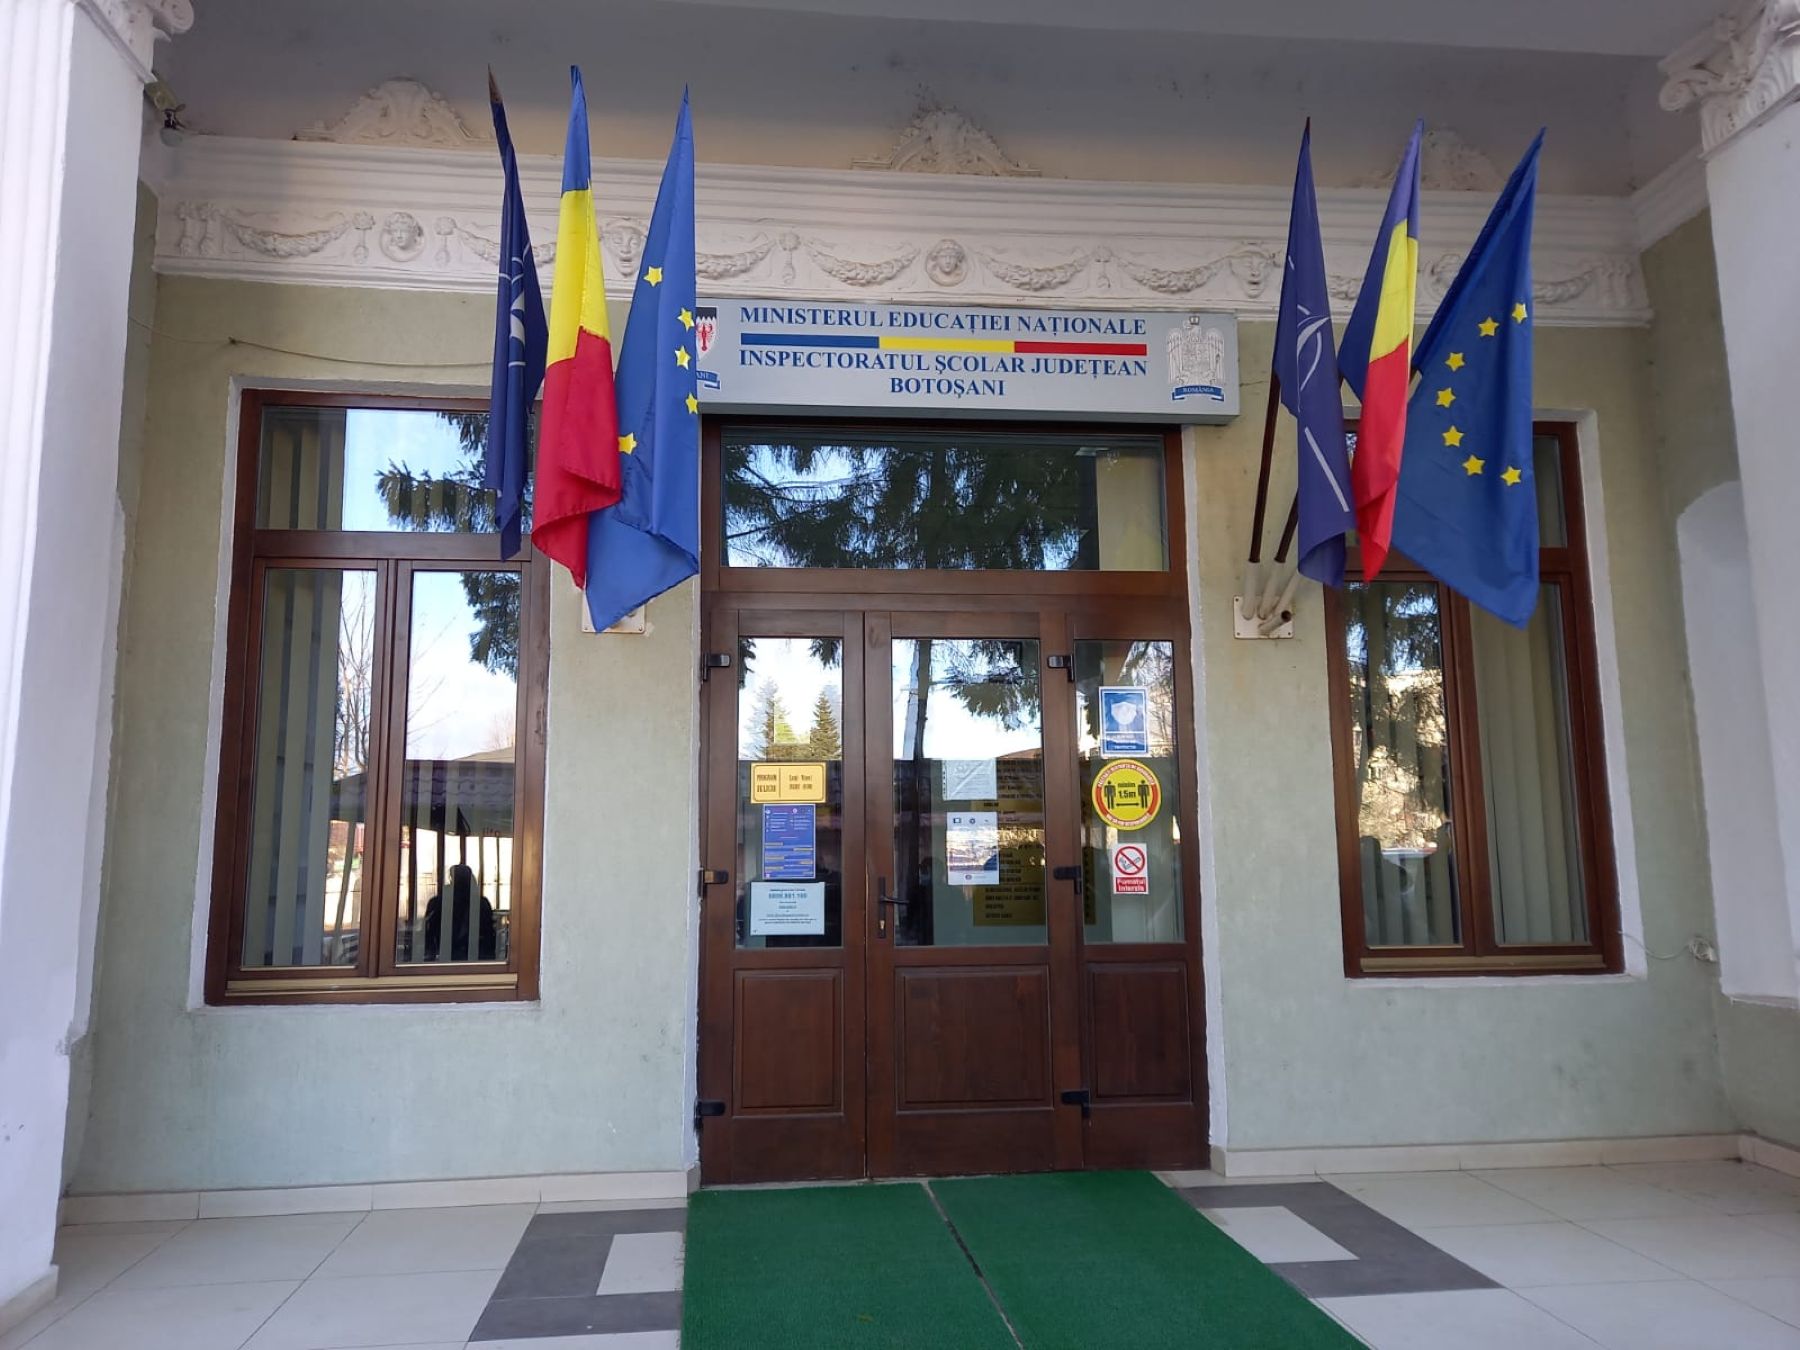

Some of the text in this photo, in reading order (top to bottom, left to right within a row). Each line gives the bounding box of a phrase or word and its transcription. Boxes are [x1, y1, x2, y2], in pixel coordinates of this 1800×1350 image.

[740, 306, 1146, 336] MINISTERUL EDUCAȚIEI NAȚIONALE
[739, 350, 929, 371] INSPECTORATUL
[1031, 358, 1148, 379] JUDEȚEAN
